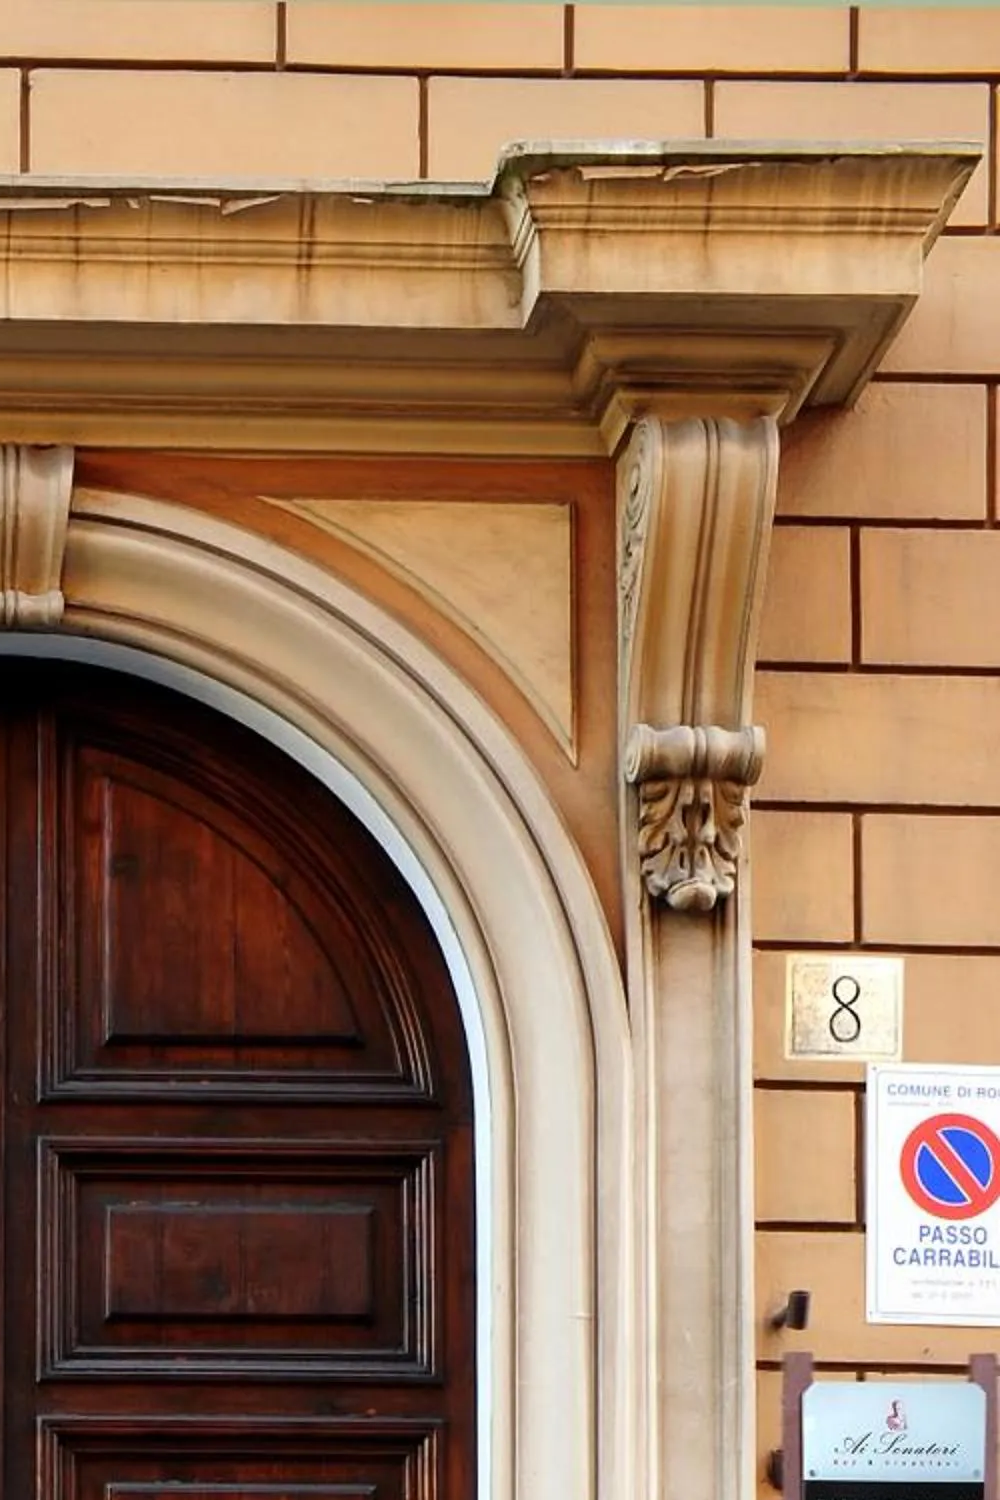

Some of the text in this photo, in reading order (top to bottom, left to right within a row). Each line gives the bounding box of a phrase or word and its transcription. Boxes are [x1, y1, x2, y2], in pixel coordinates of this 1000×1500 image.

[829, 975, 861, 1043] 8
[887, 1083, 1000, 1099] COMUNE DI RO
[919, 1225, 987, 1245] PASSO
[873, 1431, 960, 1455] Senatori
